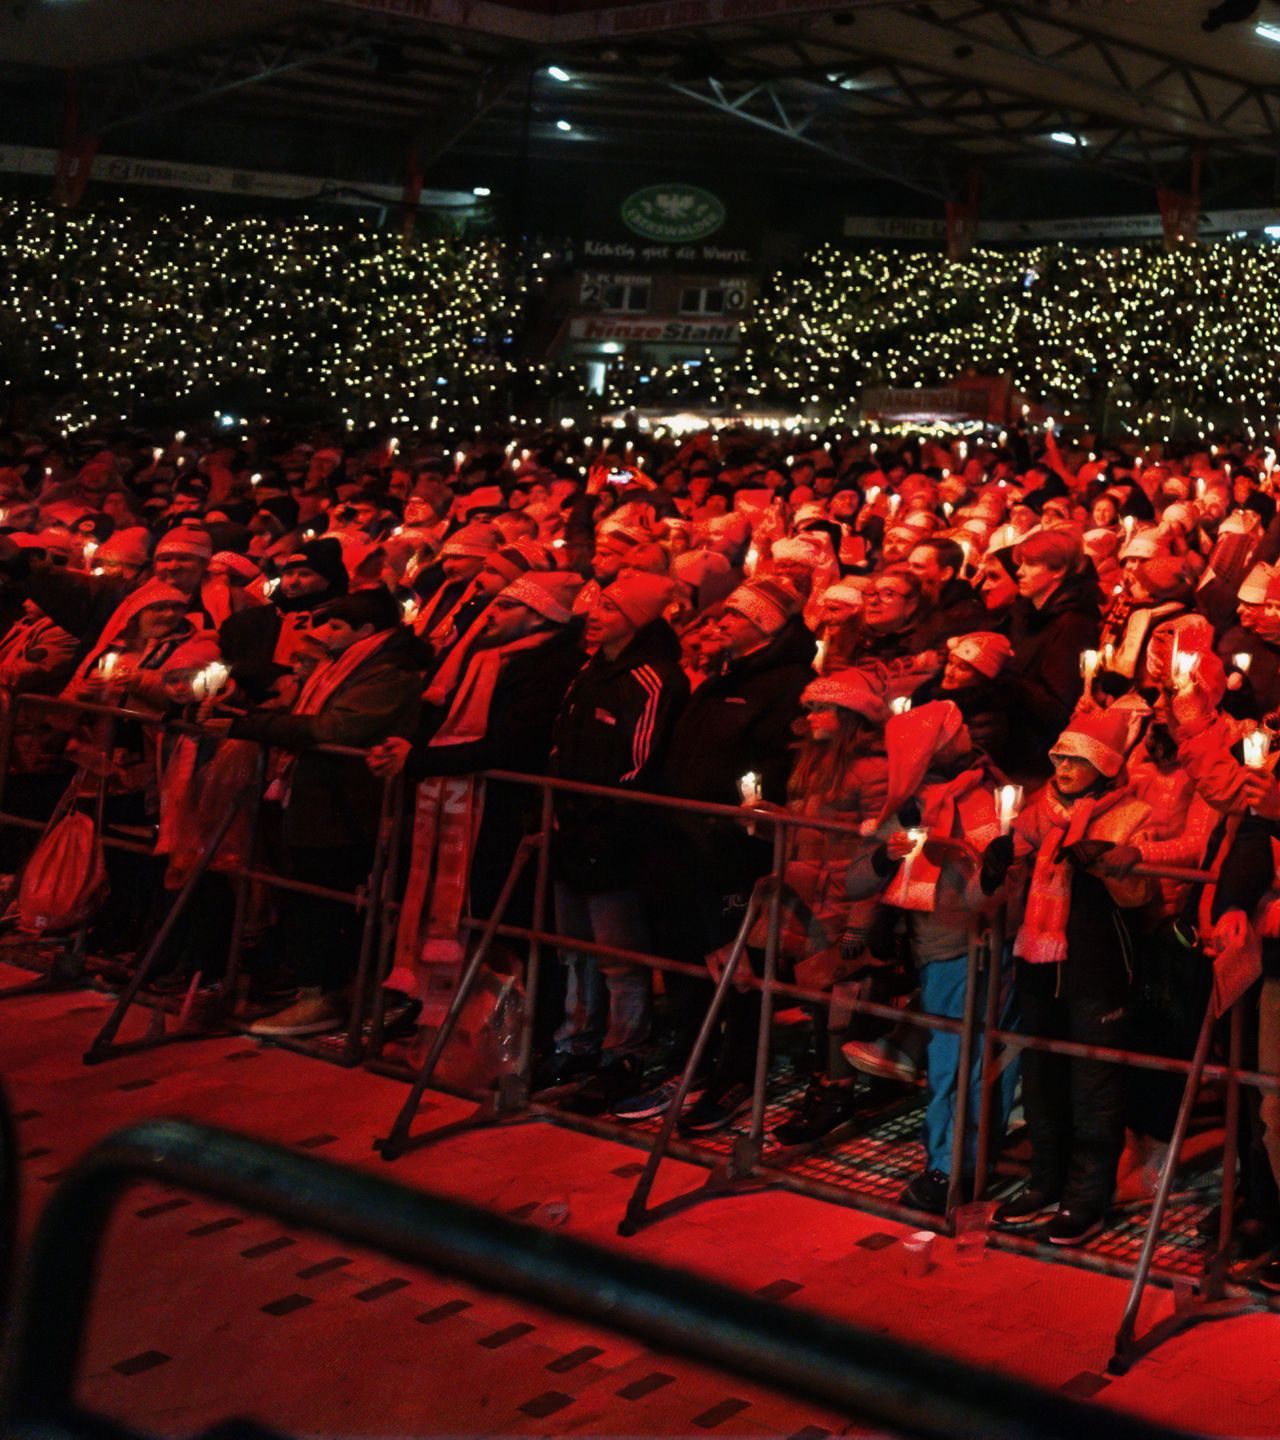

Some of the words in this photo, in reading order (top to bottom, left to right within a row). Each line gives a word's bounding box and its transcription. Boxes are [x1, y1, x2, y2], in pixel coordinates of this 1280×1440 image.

[583, 239, 637, 261] Richtig
[640, 246, 668, 262] gut
[674, 245, 697, 261] die
